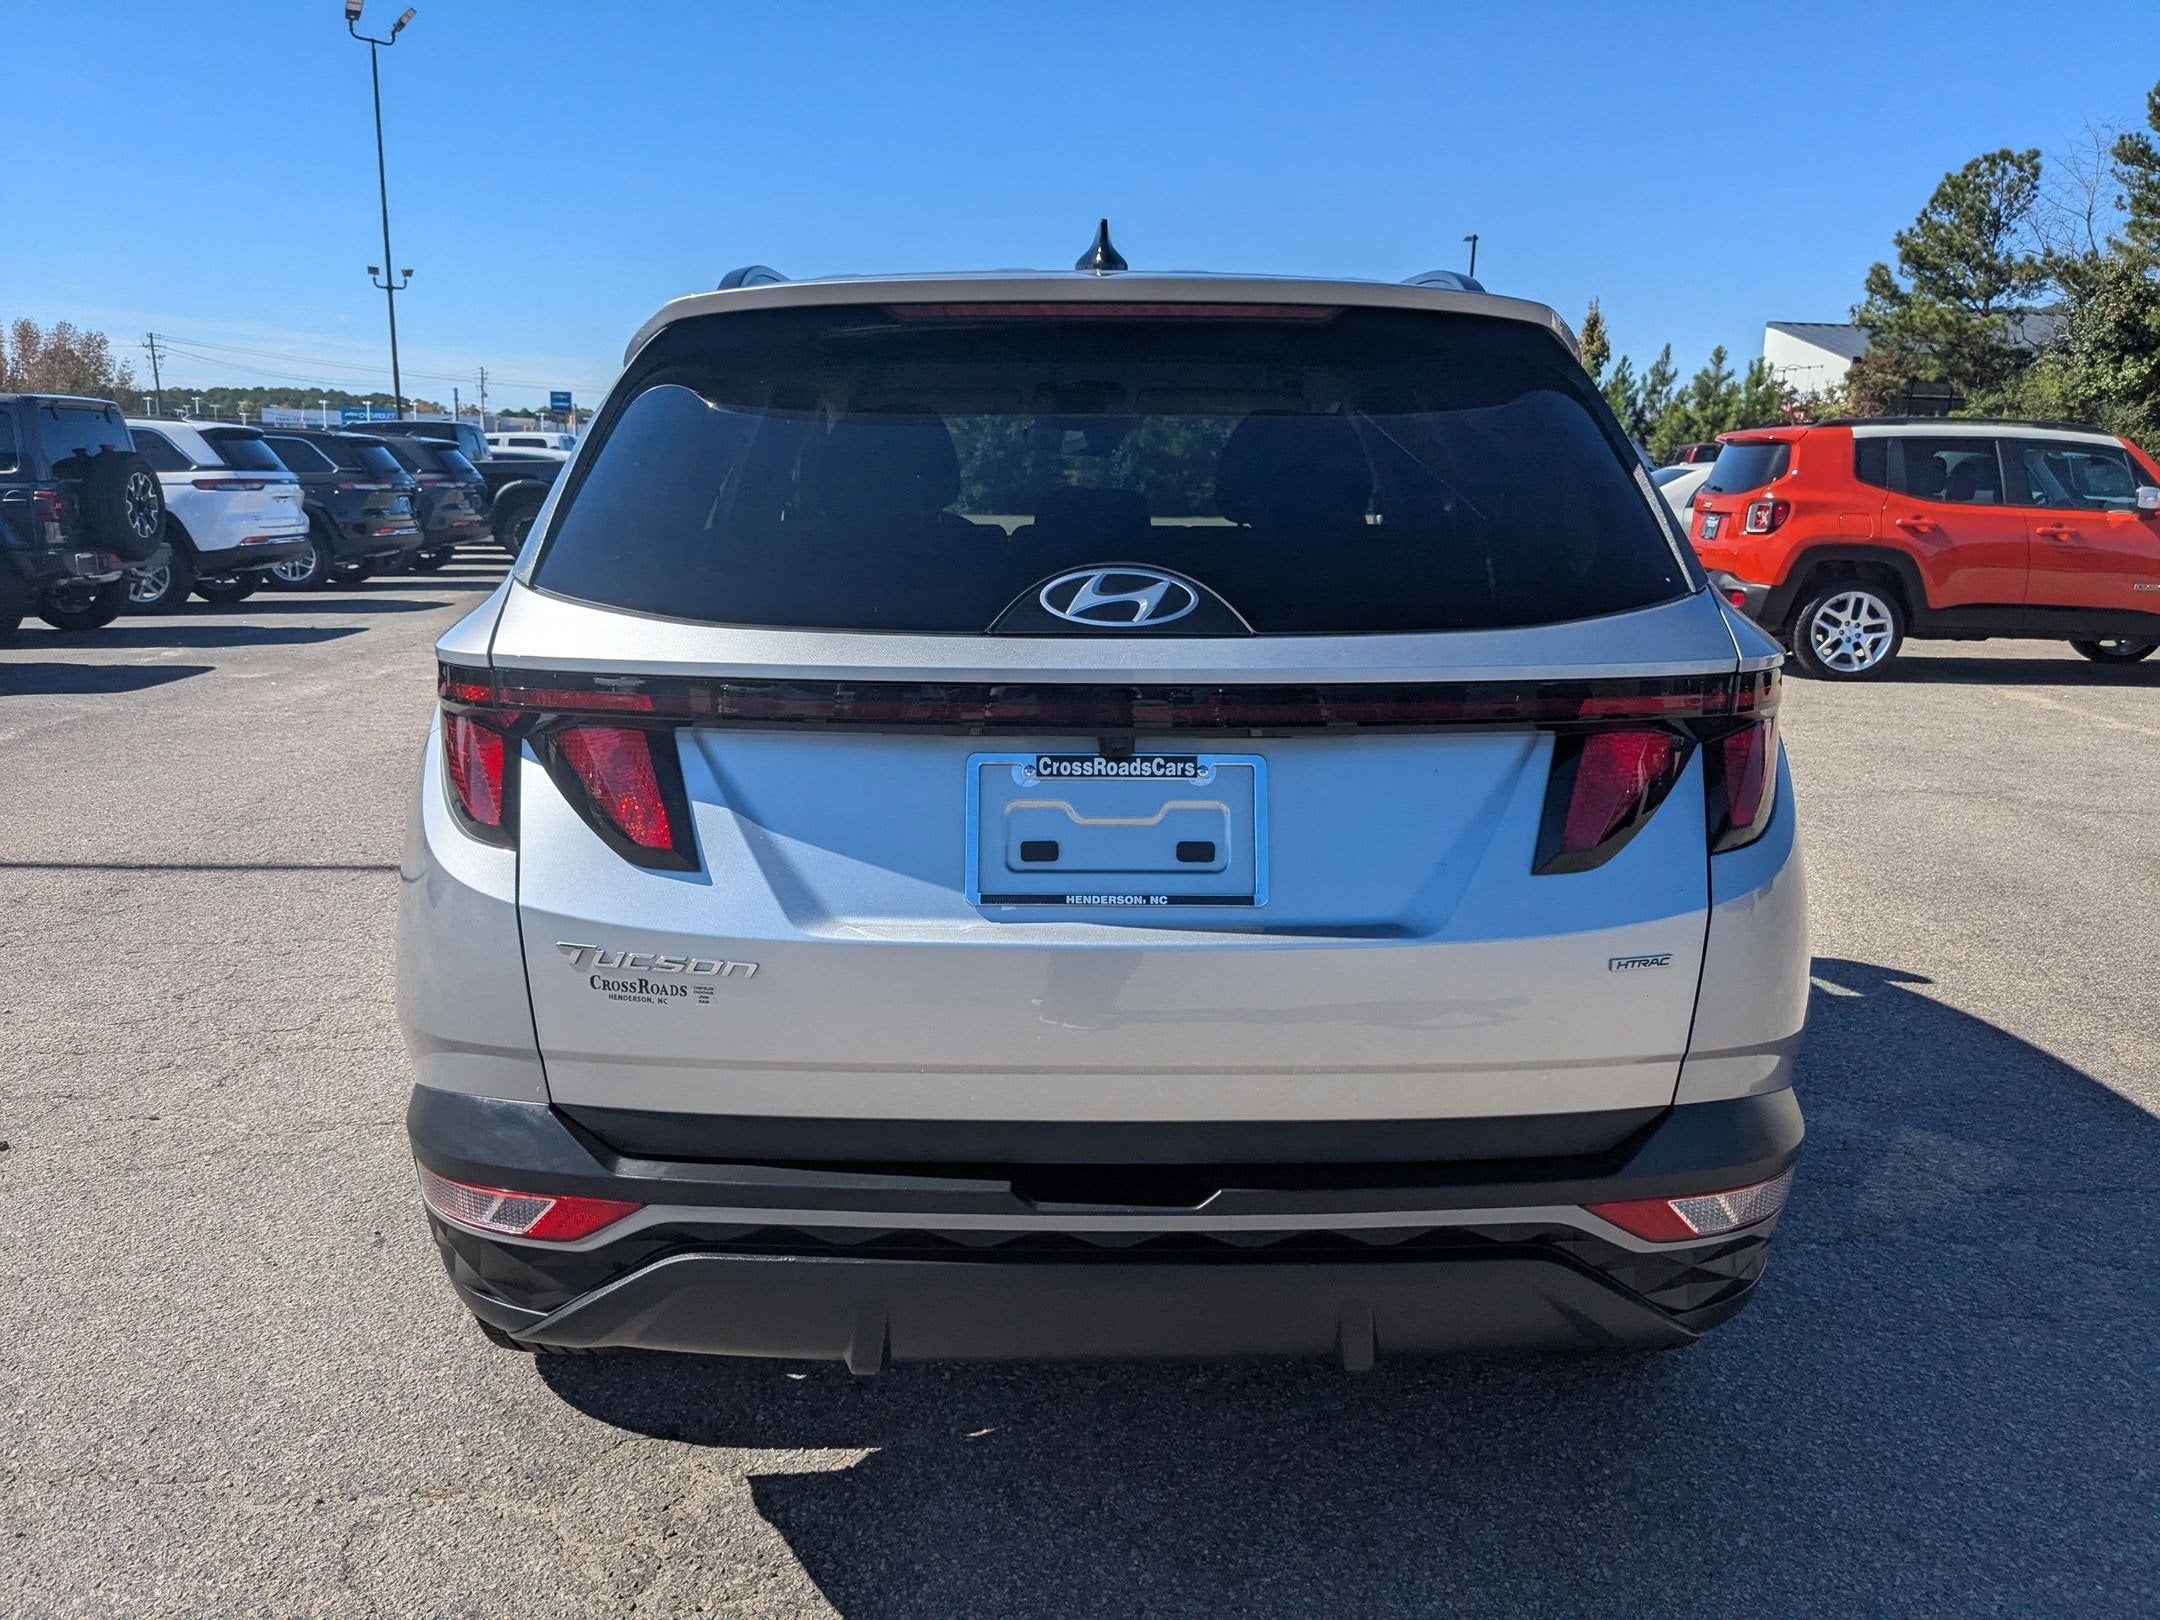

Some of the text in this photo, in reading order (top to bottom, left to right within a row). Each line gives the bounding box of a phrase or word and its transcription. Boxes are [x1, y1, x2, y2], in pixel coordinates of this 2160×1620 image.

[1038, 756, 1196, 777] CrossRoadsCars
[1066, 895, 1169, 905] HENDERSON, NC
[556, 941, 760, 978] TUCSON
[1616, 957, 1671, 969] HTRAC
[608, 993, 669, 1005] HENDERSON, NC
